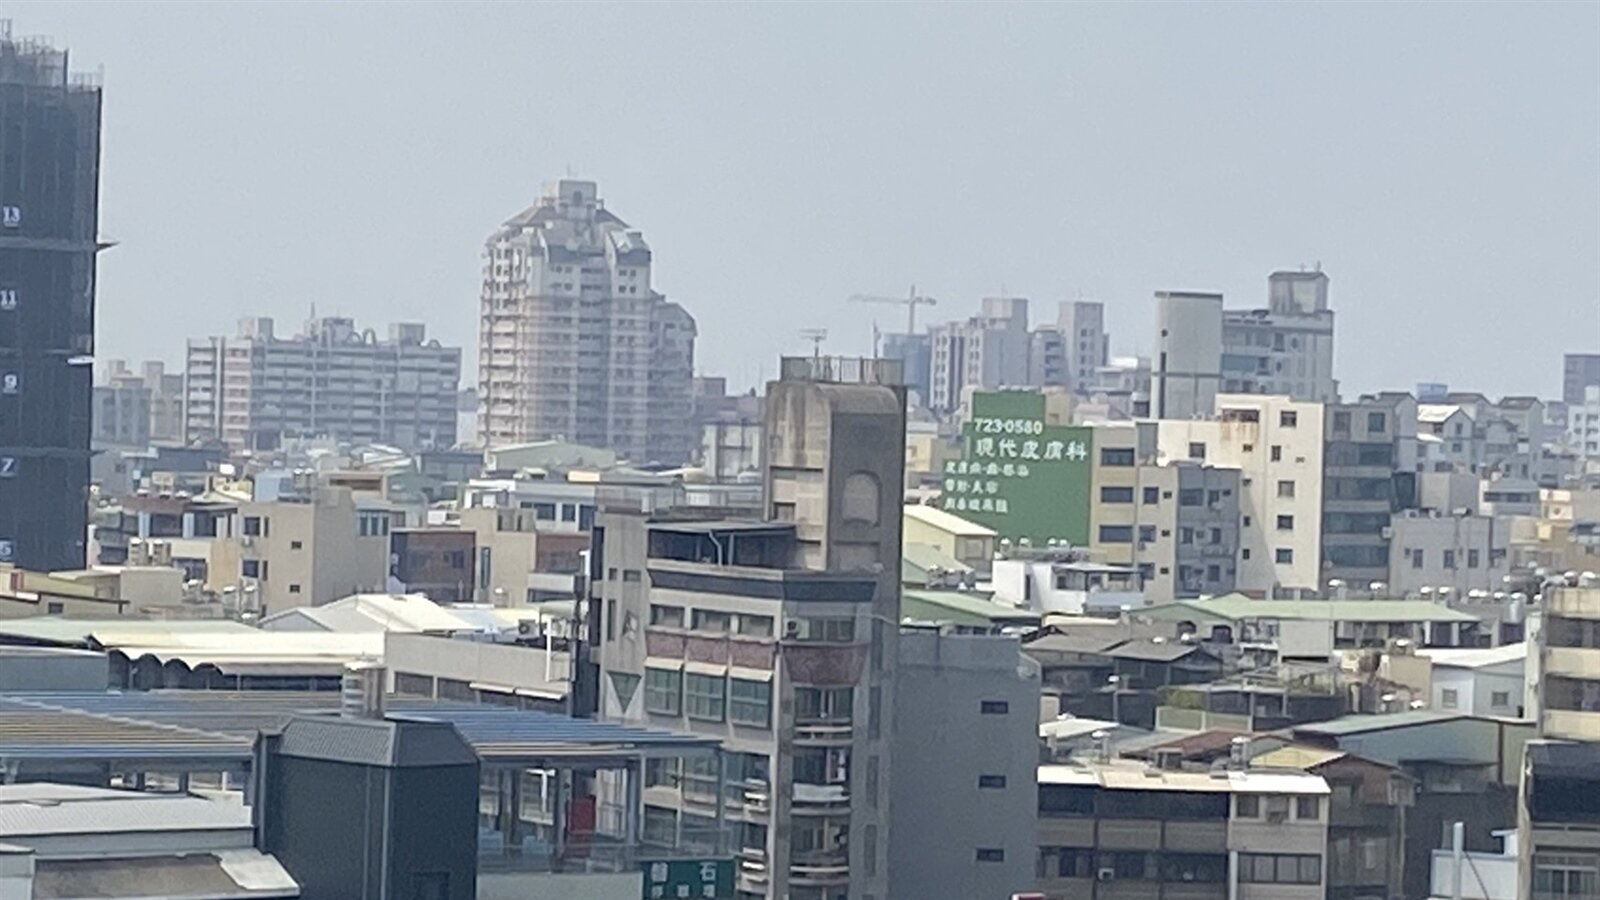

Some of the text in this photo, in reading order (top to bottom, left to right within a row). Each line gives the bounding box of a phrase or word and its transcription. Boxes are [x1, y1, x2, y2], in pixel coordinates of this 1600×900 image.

[3, 206, 20, 223] 13
[976, 438, 1087, 460] 現代皮膚科
[1, 458, 14, 472] 7
